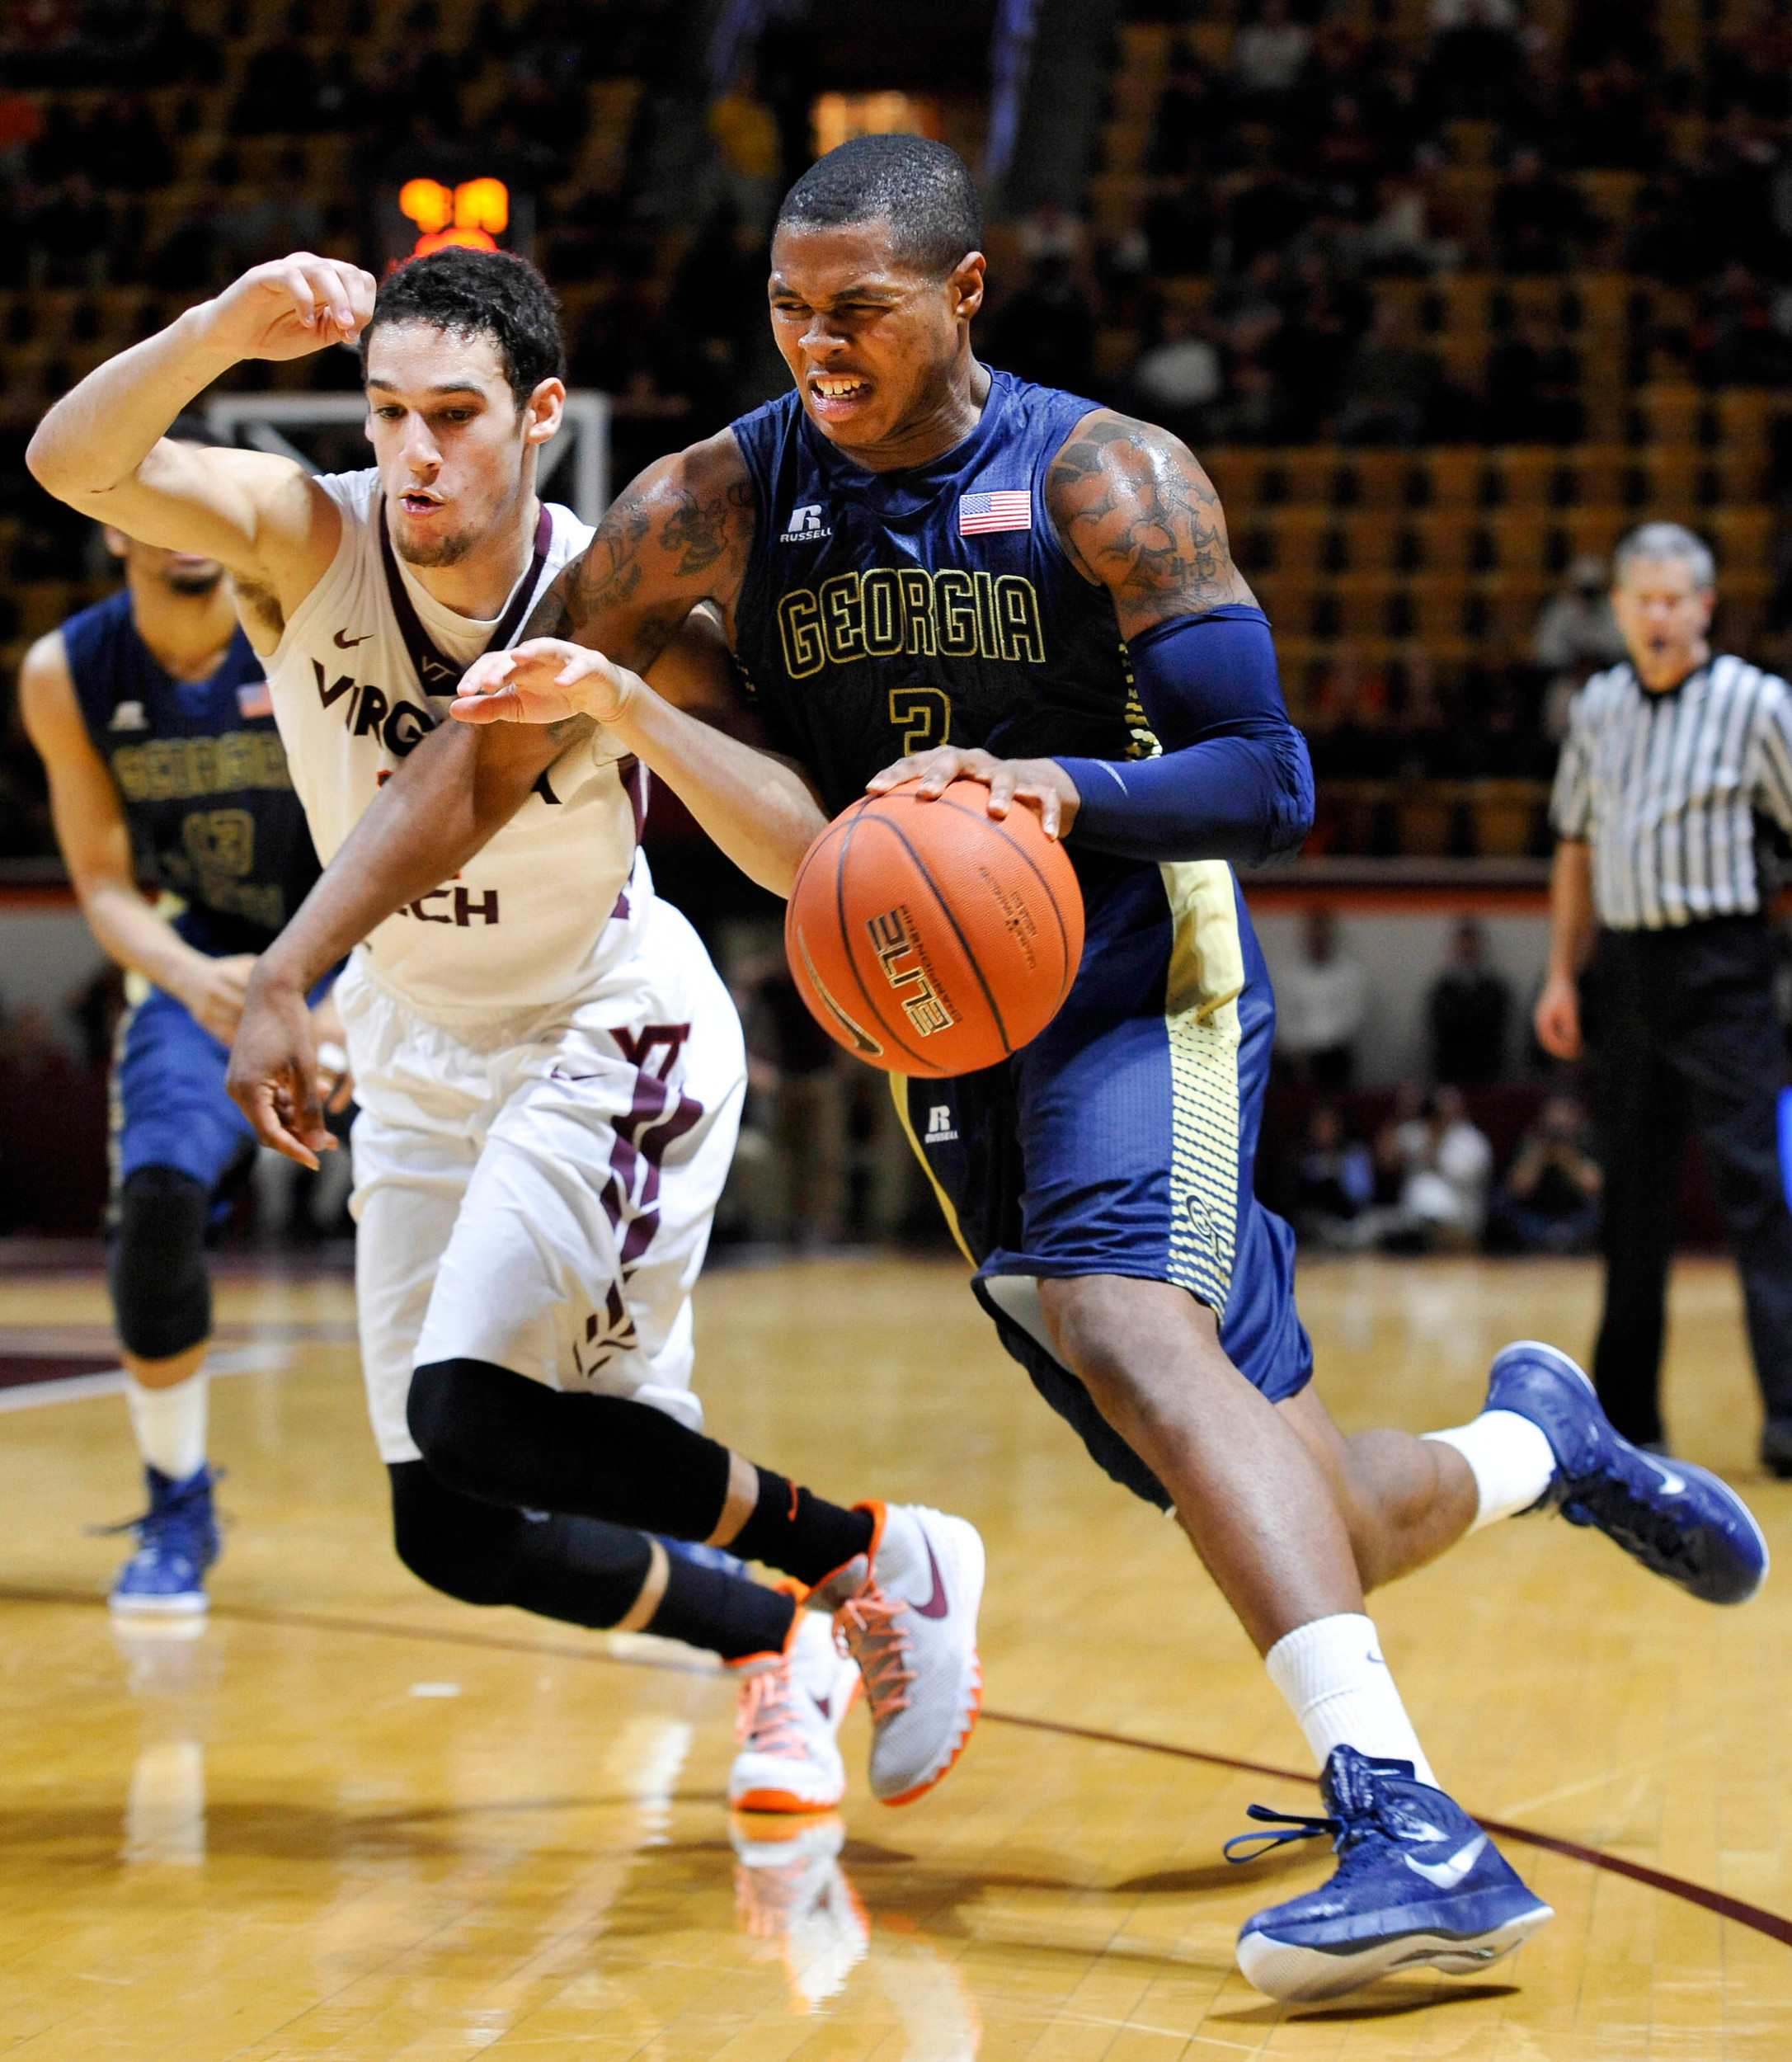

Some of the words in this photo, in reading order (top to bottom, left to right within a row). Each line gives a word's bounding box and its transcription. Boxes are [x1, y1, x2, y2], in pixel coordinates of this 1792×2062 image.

[780, 527, 832, 543] RUSSELL
[778, 568, 1046, 679] GEORGIA
[396, 887, 499, 927] CH
[866, 908, 954, 1038] ELITE
